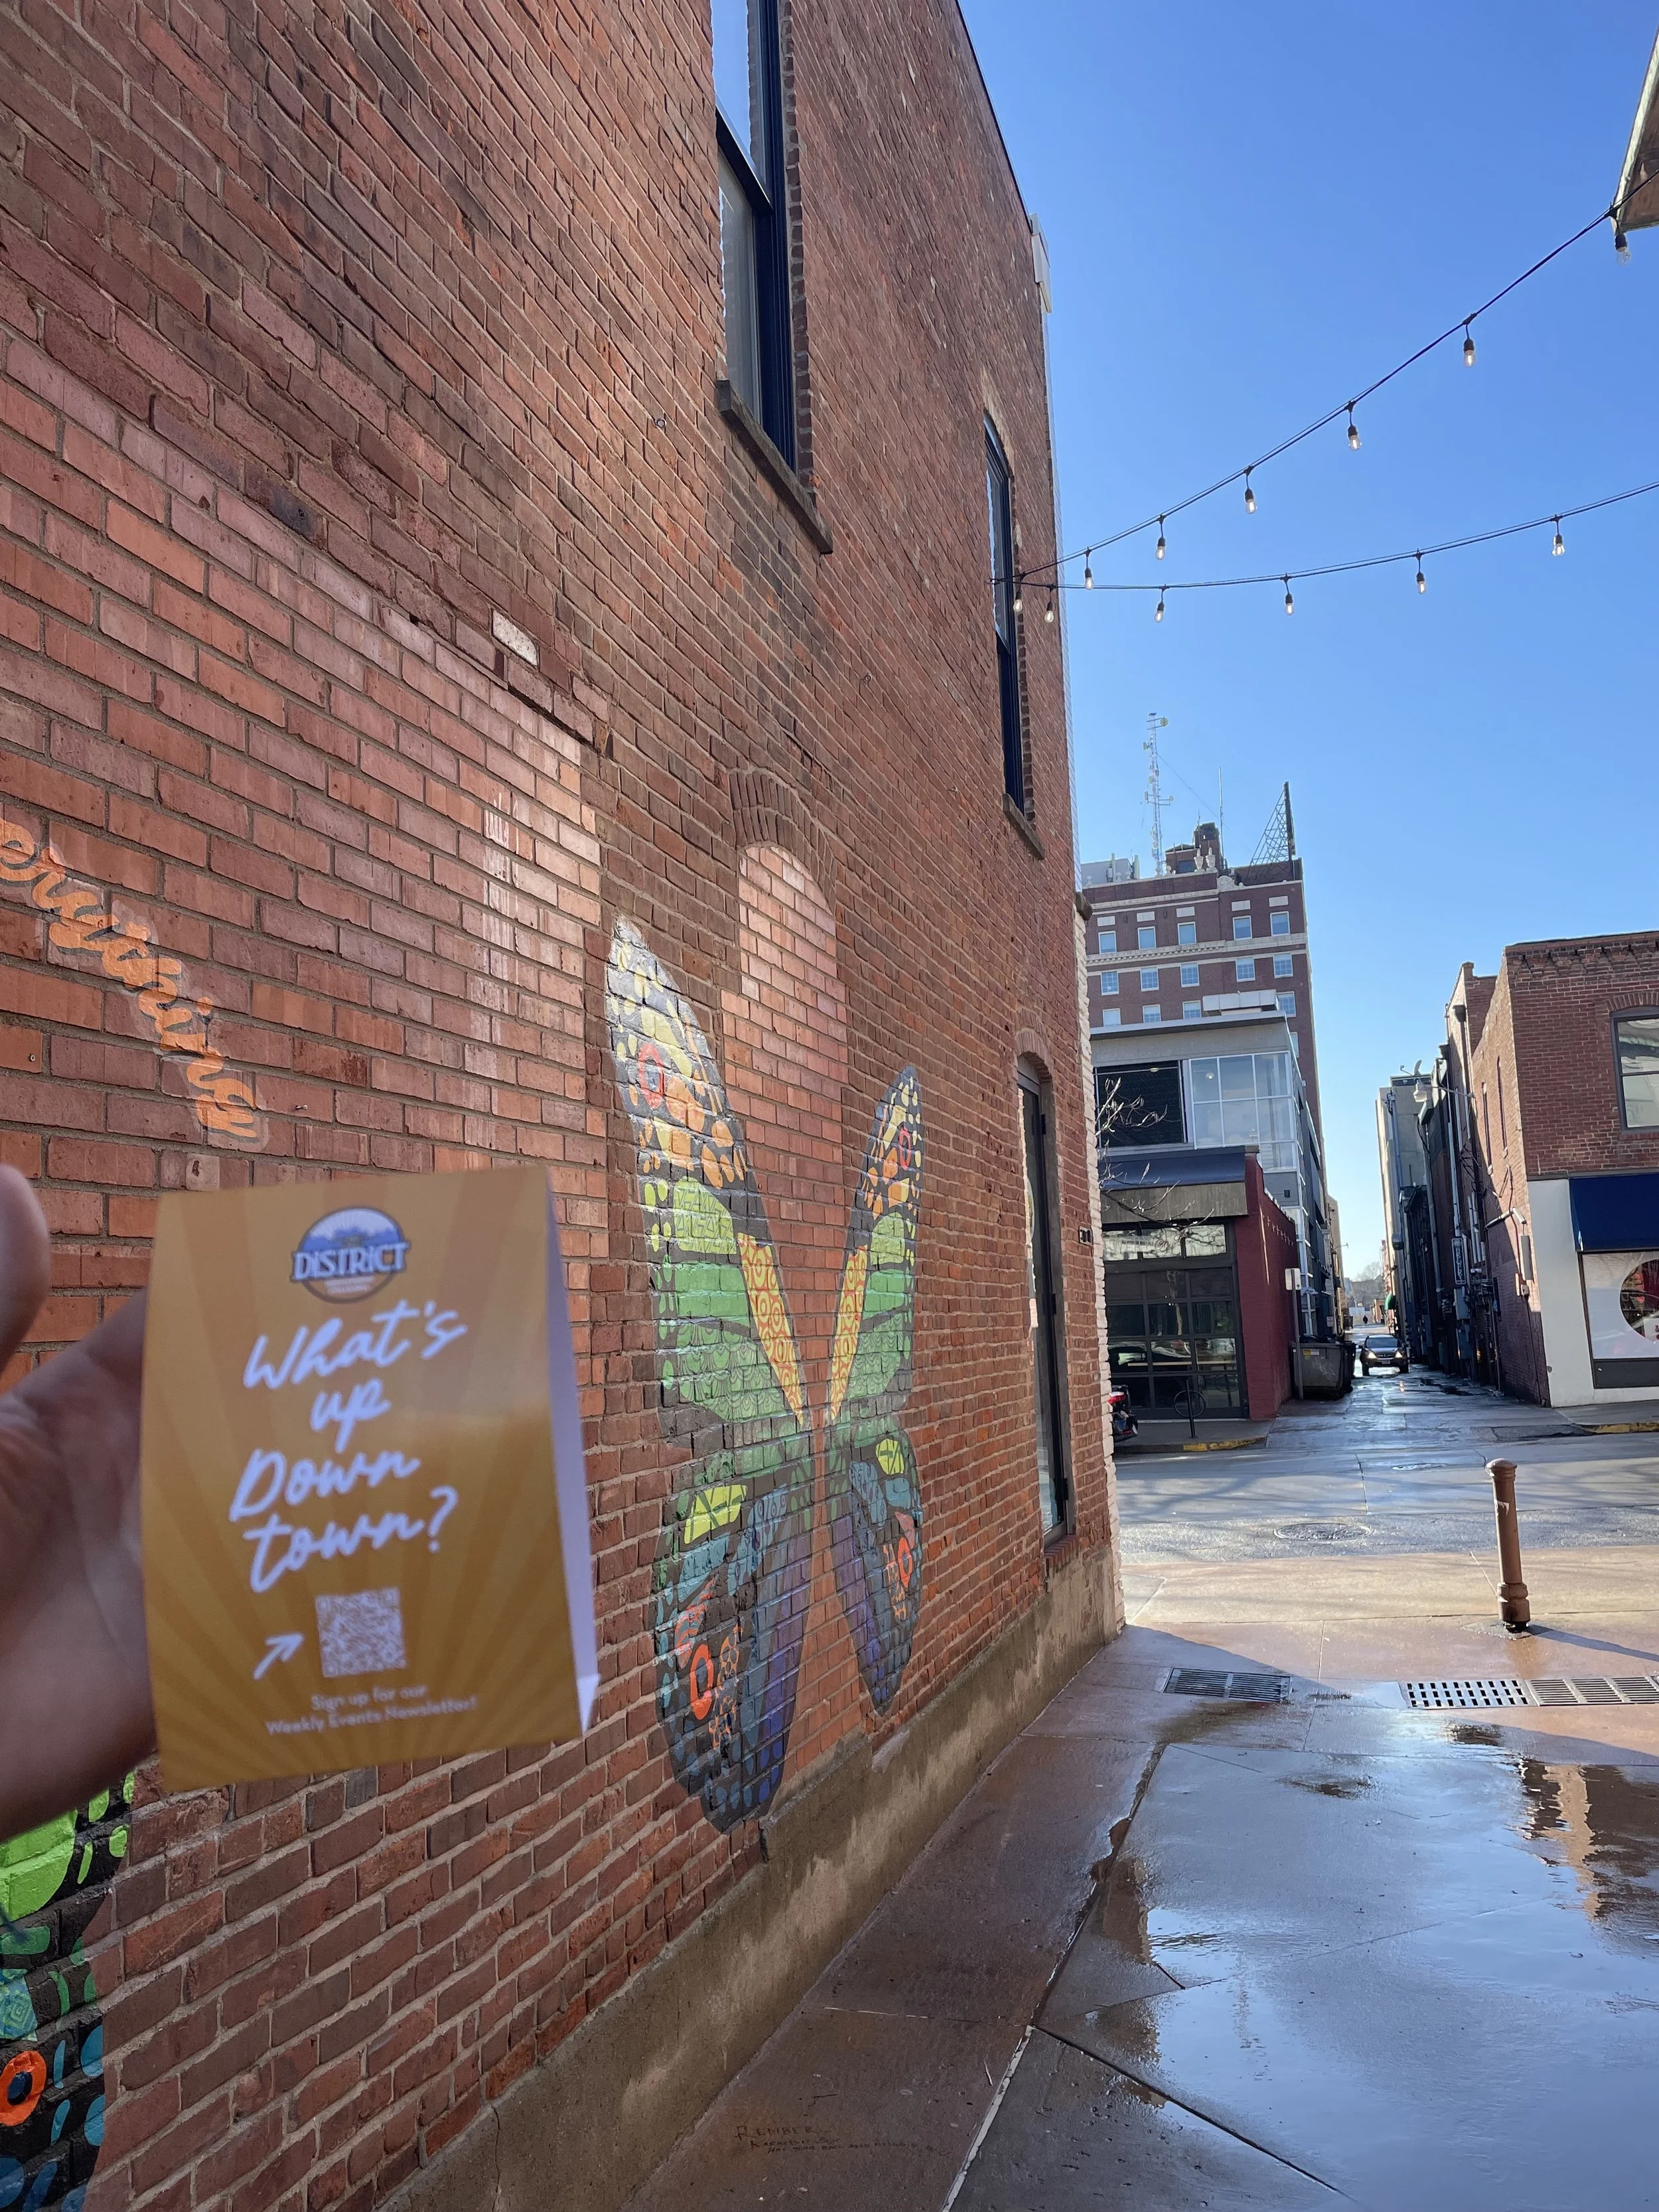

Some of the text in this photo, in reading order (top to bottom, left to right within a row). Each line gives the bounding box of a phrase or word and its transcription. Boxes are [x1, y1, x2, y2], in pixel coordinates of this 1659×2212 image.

[243, 1299, 468, 1389] What's
[310, 1378, 392, 1454] up
[228, 1448, 422, 1523] Down
[243, 1484, 459, 1593] town?
[265, 1716, 325, 1735] Weekly
[328, 1710, 382, 1728] Events
[311, 1684, 429, 1712] Sign up for our
